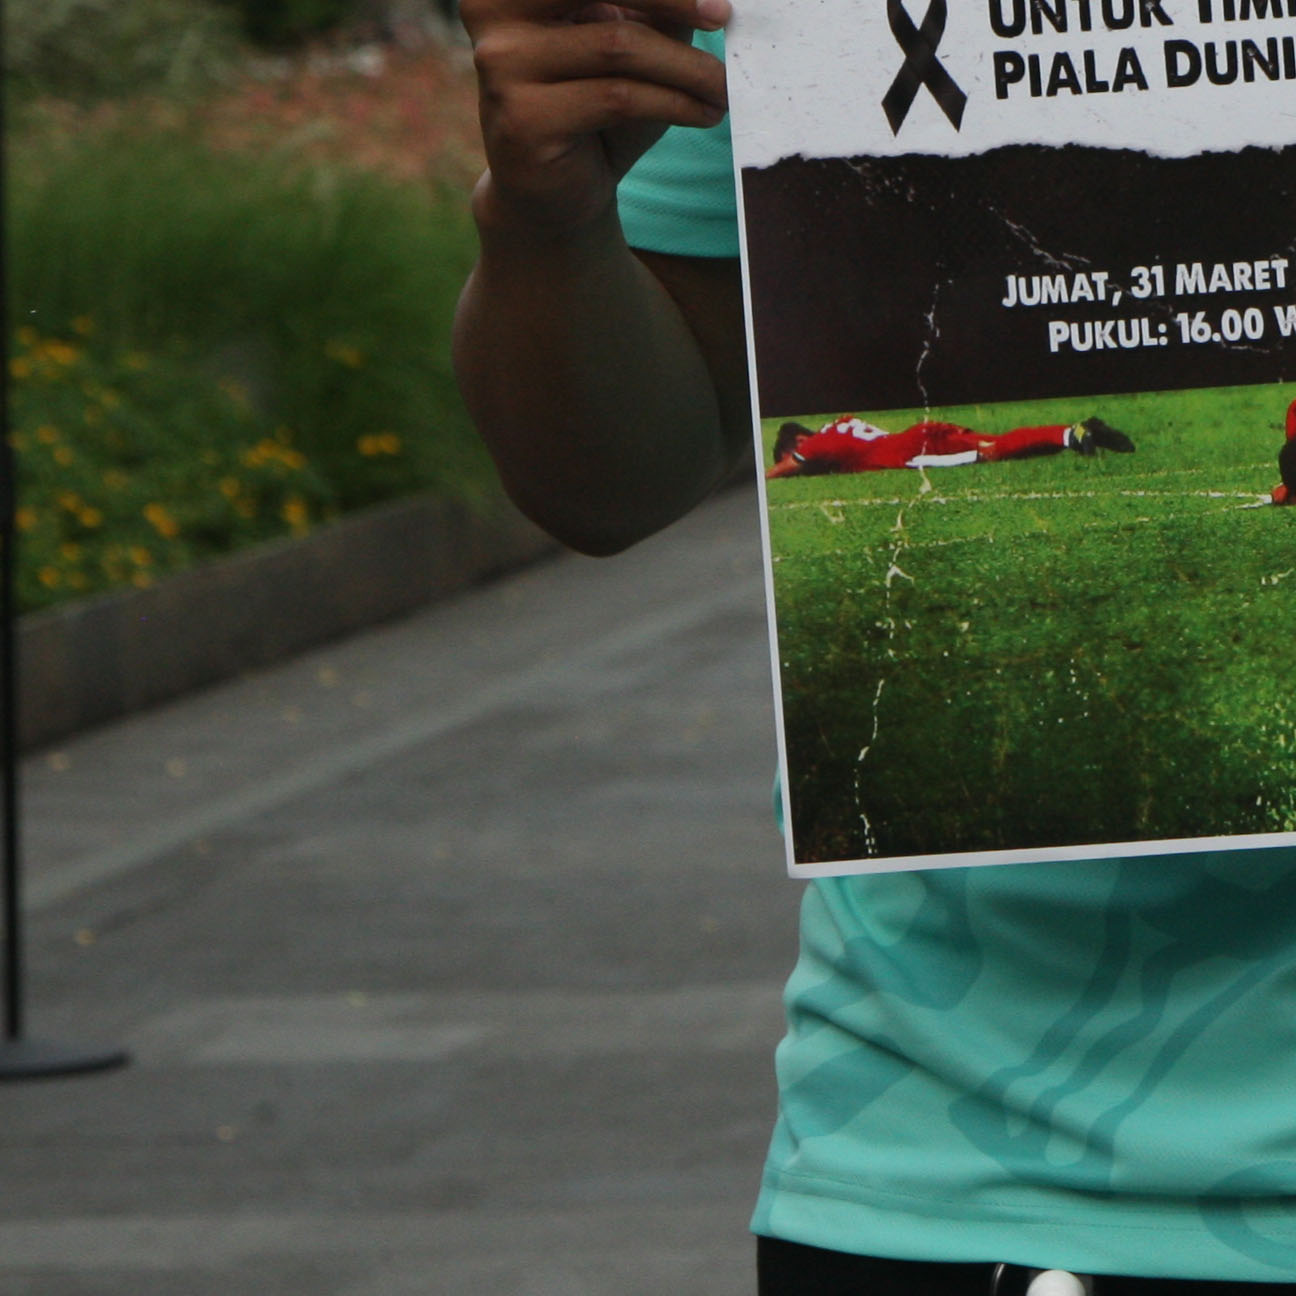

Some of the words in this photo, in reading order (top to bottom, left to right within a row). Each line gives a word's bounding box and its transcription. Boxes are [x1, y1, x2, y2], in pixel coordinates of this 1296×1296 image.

[992, 46, 1149, 100] PIALA
[1002, 271, 1122, 308] JUMAT,
[1130, 265, 1165, 299] 31
[1175, 258, 1289, 296] MARET
[1048, 317, 1168, 353] PUKUL:
[1175, 307, 1265, 344] 16.00
